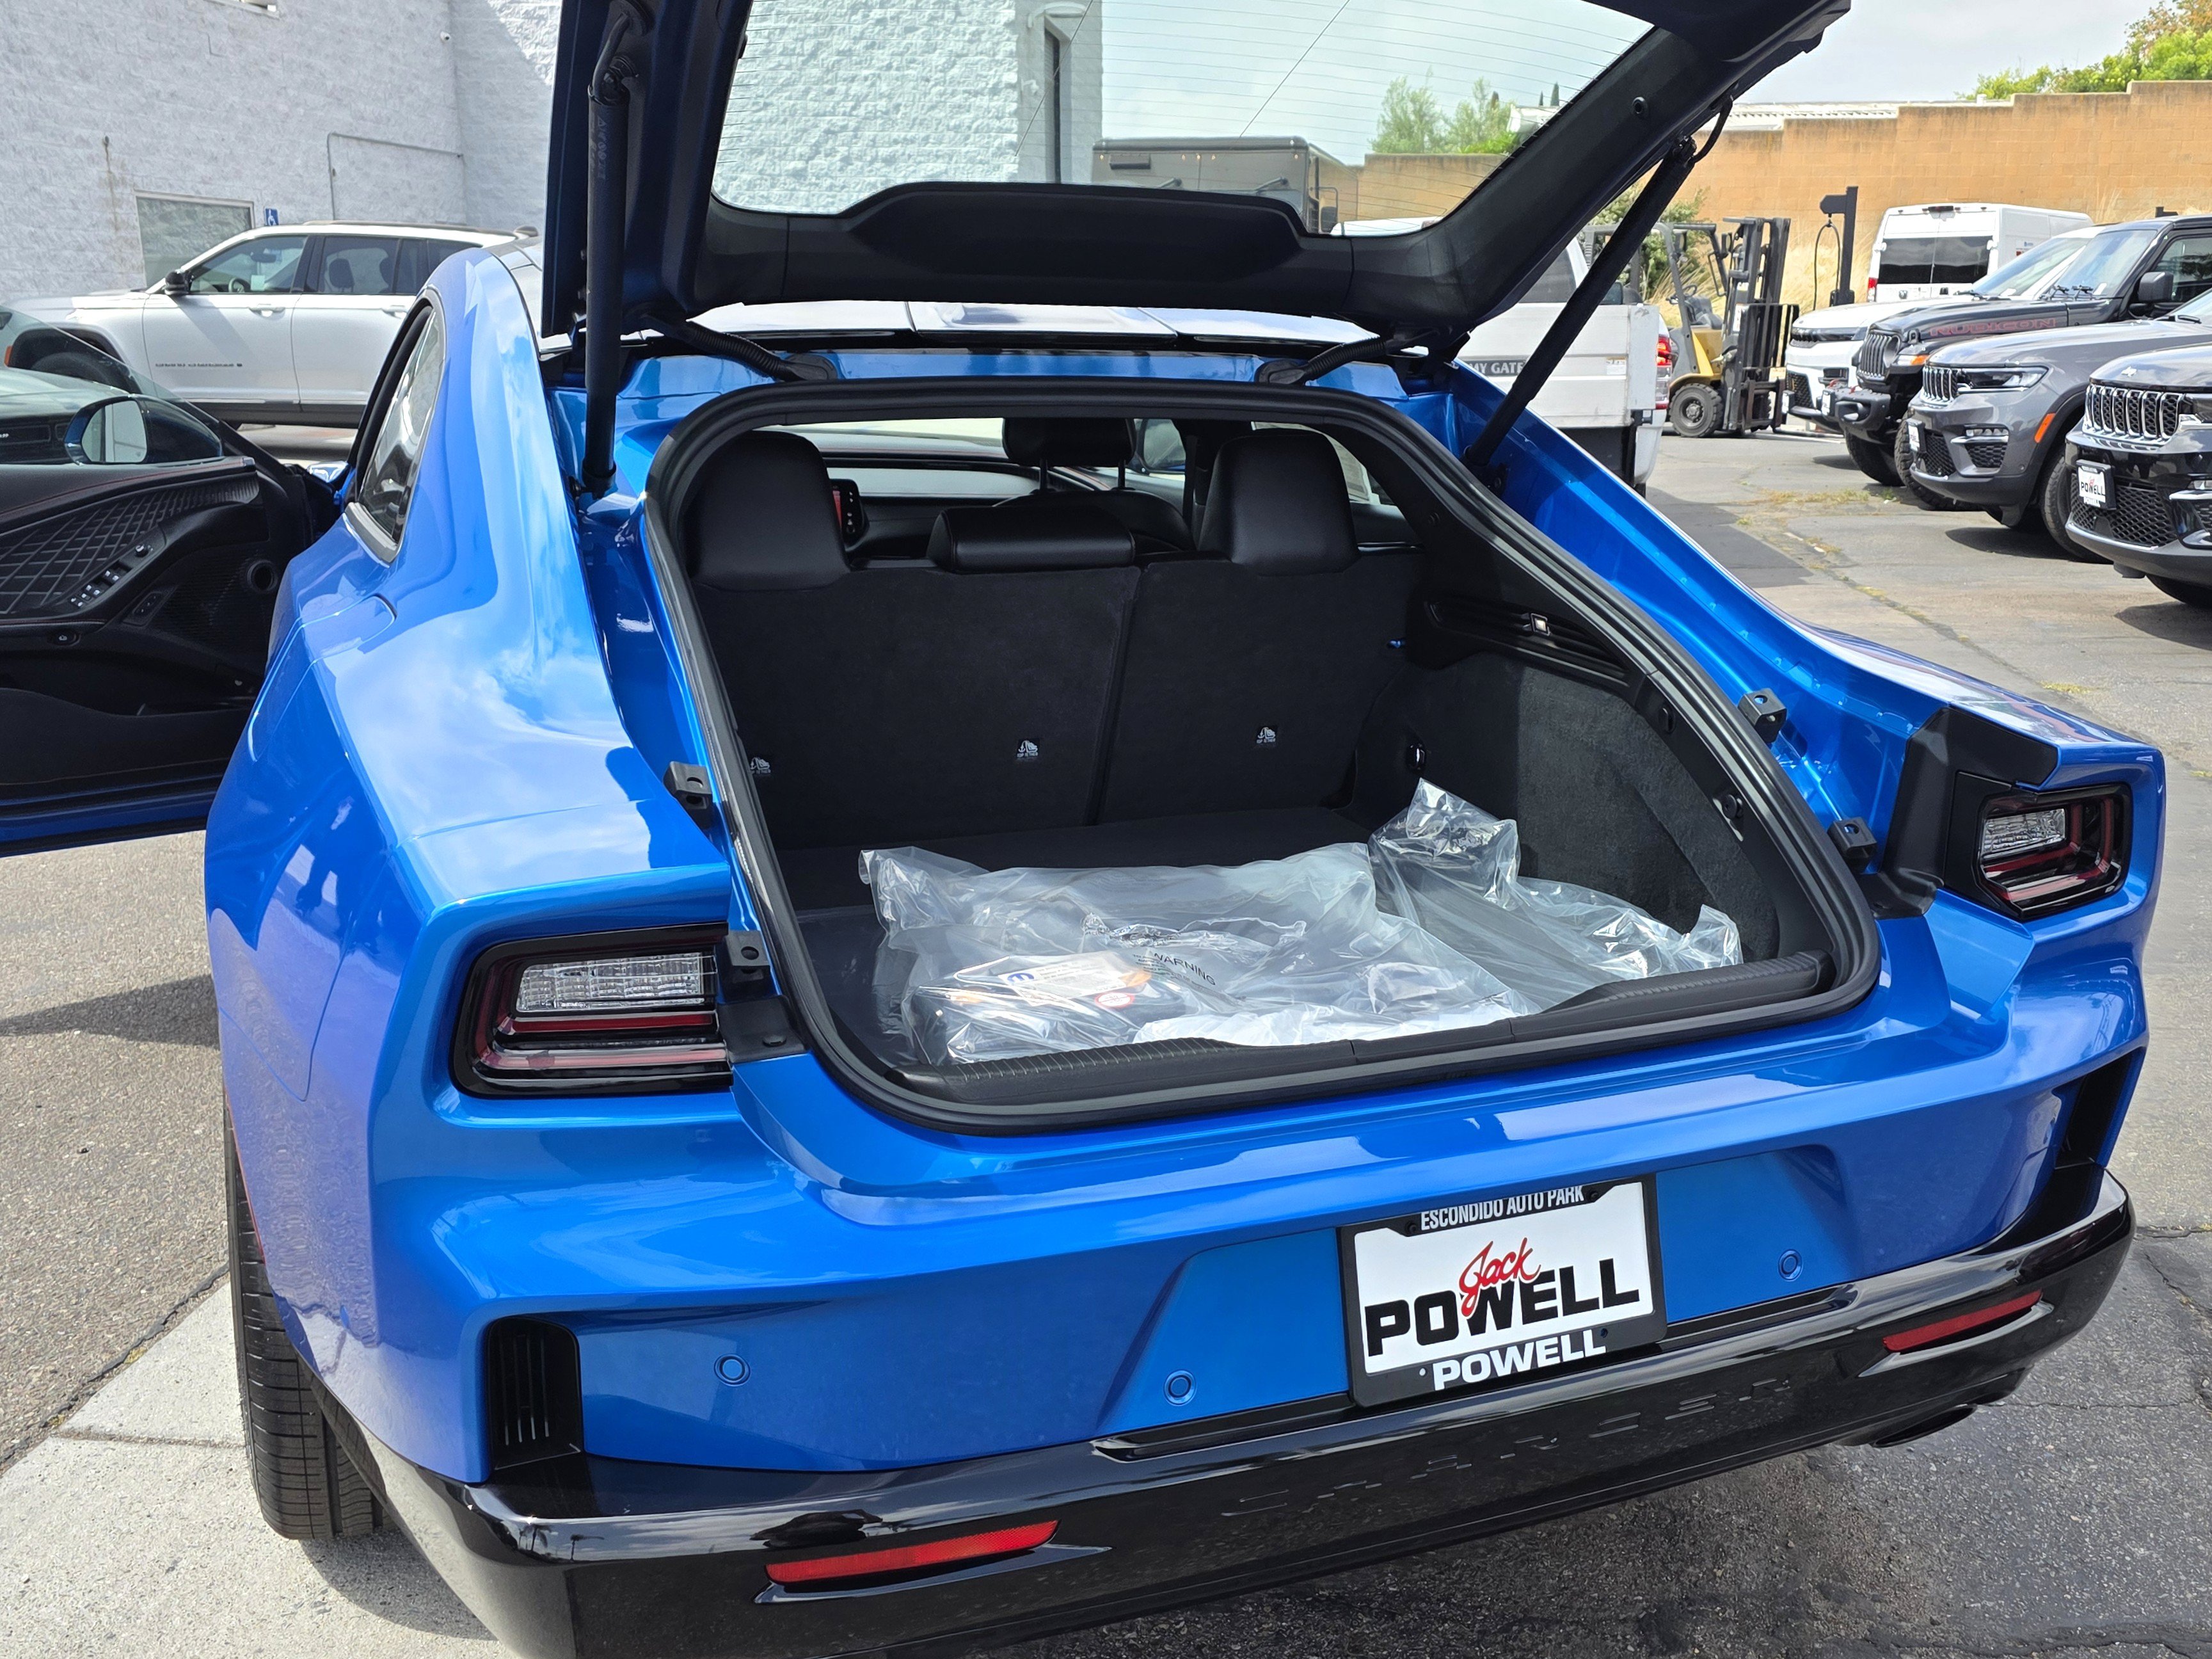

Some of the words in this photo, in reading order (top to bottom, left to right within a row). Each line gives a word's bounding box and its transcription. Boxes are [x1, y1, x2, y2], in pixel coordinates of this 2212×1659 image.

[1929, 318, 2057, 337] RUBICON
[1420, 1199, 1503, 1231] ESCONDIDO
[1506, 1192, 1544, 1215] AUTO
[1547, 1185, 1584, 1206] PARK
[1365, 1258, 1639, 1357] POWELL
[1459, 1237, 1541, 1317] Jack
[1433, 1329, 1606, 1391] POWELL
